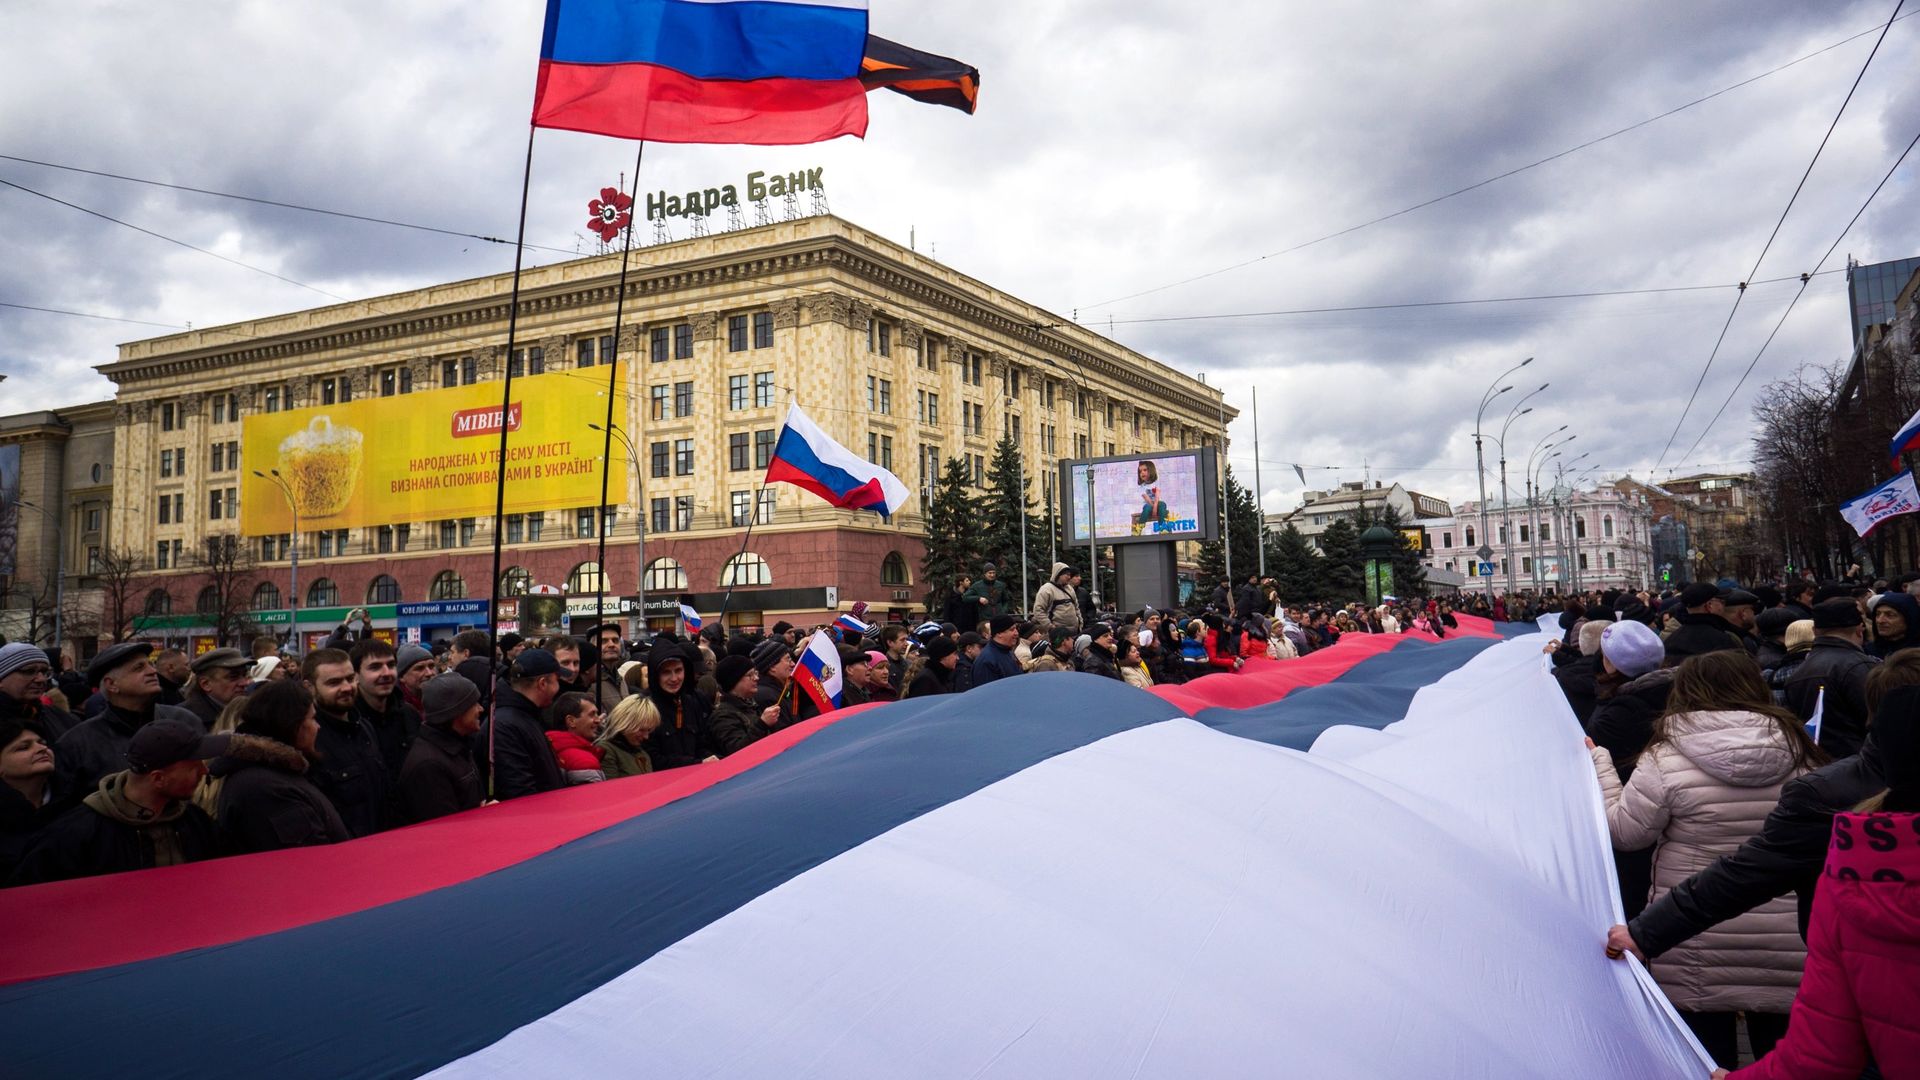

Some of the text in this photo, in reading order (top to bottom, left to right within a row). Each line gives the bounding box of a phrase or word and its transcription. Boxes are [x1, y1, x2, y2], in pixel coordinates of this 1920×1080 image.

[647, 166, 823, 221] Надра Банк
[409, 453, 478, 472] НАРОДЖЕНА
[480, 451, 487, 465] У
[537, 441, 571, 458] МІСТІ
[391, 475, 440, 493] ВИЗНАНА
[443, 465, 531, 488] СПОЖИВААМИ
[535, 465, 542, 479] В
[402, 603, 479, 614] ЮВЕЛІРНИЙ МАГАЗИН
[581, 602, 621, 611] AGRCOLE
[631, 601, 661, 610] Plainum
[662, 599, 681, 609] Bank
